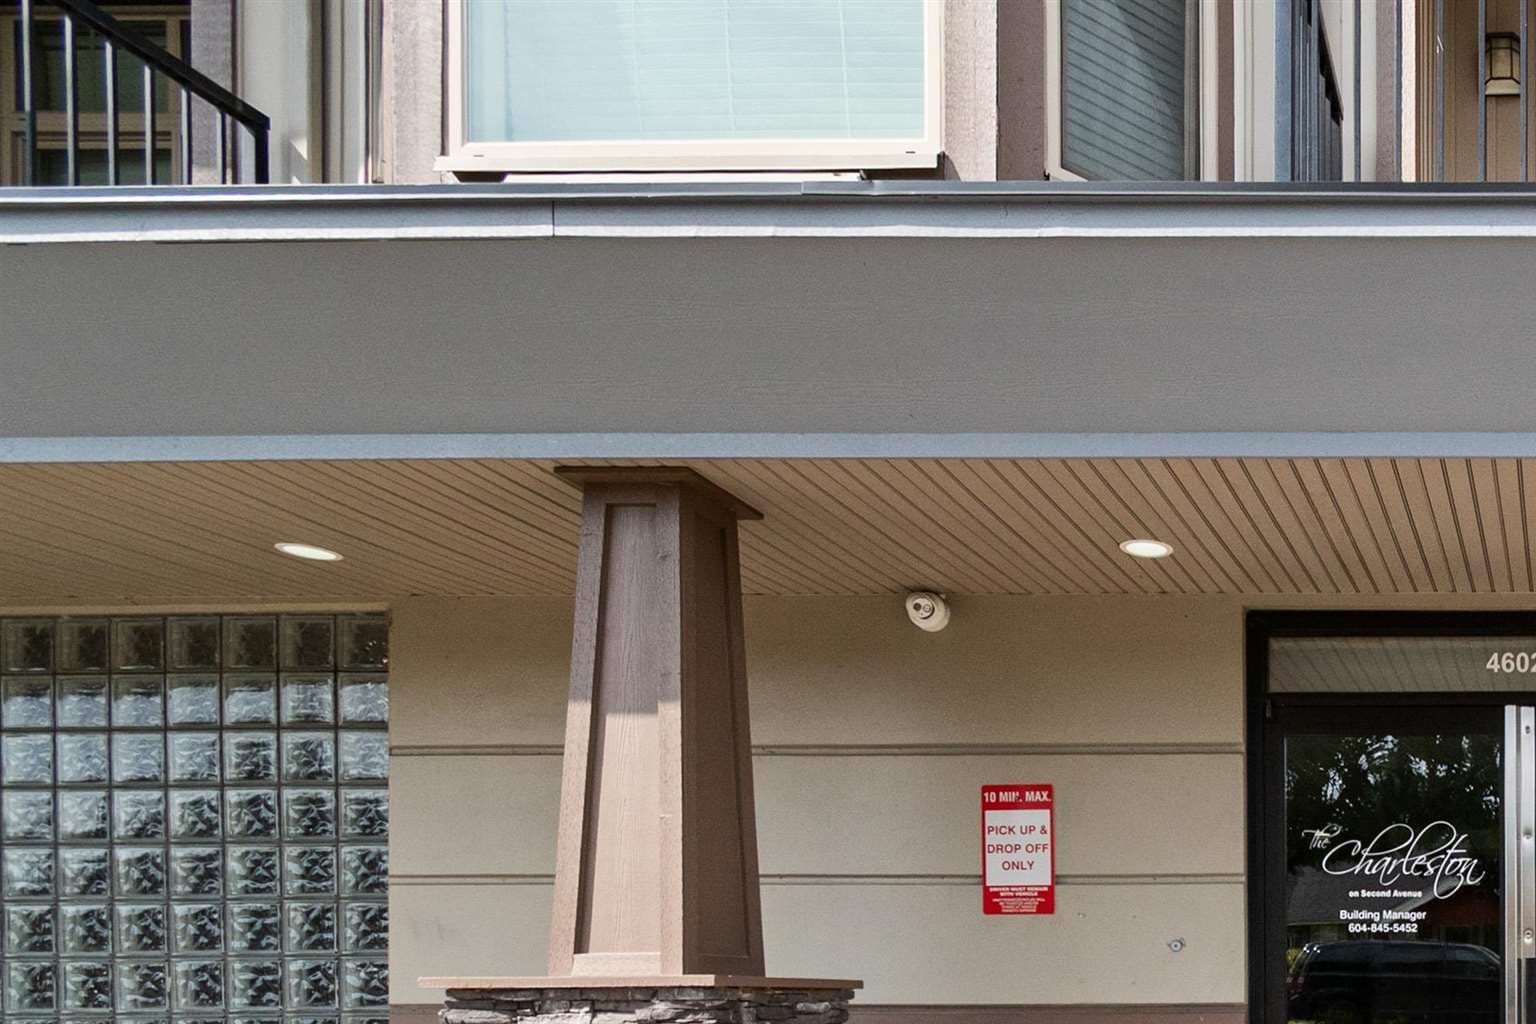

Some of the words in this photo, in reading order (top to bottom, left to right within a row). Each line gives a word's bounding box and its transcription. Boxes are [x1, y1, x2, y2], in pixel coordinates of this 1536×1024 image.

[983, 791, 997, 803] 10
[1025, 790, 1052, 802] MAX.
[987, 825, 1016, 836] PICK
[1020, 825, 1036, 836] UP
[1039, 825, 1048, 836] &
[987, 843, 1021, 854] DROP
[1025, 843, 1049, 854] OFF
[1001, 860, 1035, 871] ONLY
[1302, 823, 1342, 849] The
[1322, 820, 1486, 900] Charleston
[1348, 890, 1360, 898] on
[1361, 889, 1392, 898] Second
[1392, 889, 1422, 898] Avenue
[1339, 910, 1380, 922] Building
[1382, 910, 1427, 922] Manager
[1348, 923, 1418, 933] 604-845-5452
